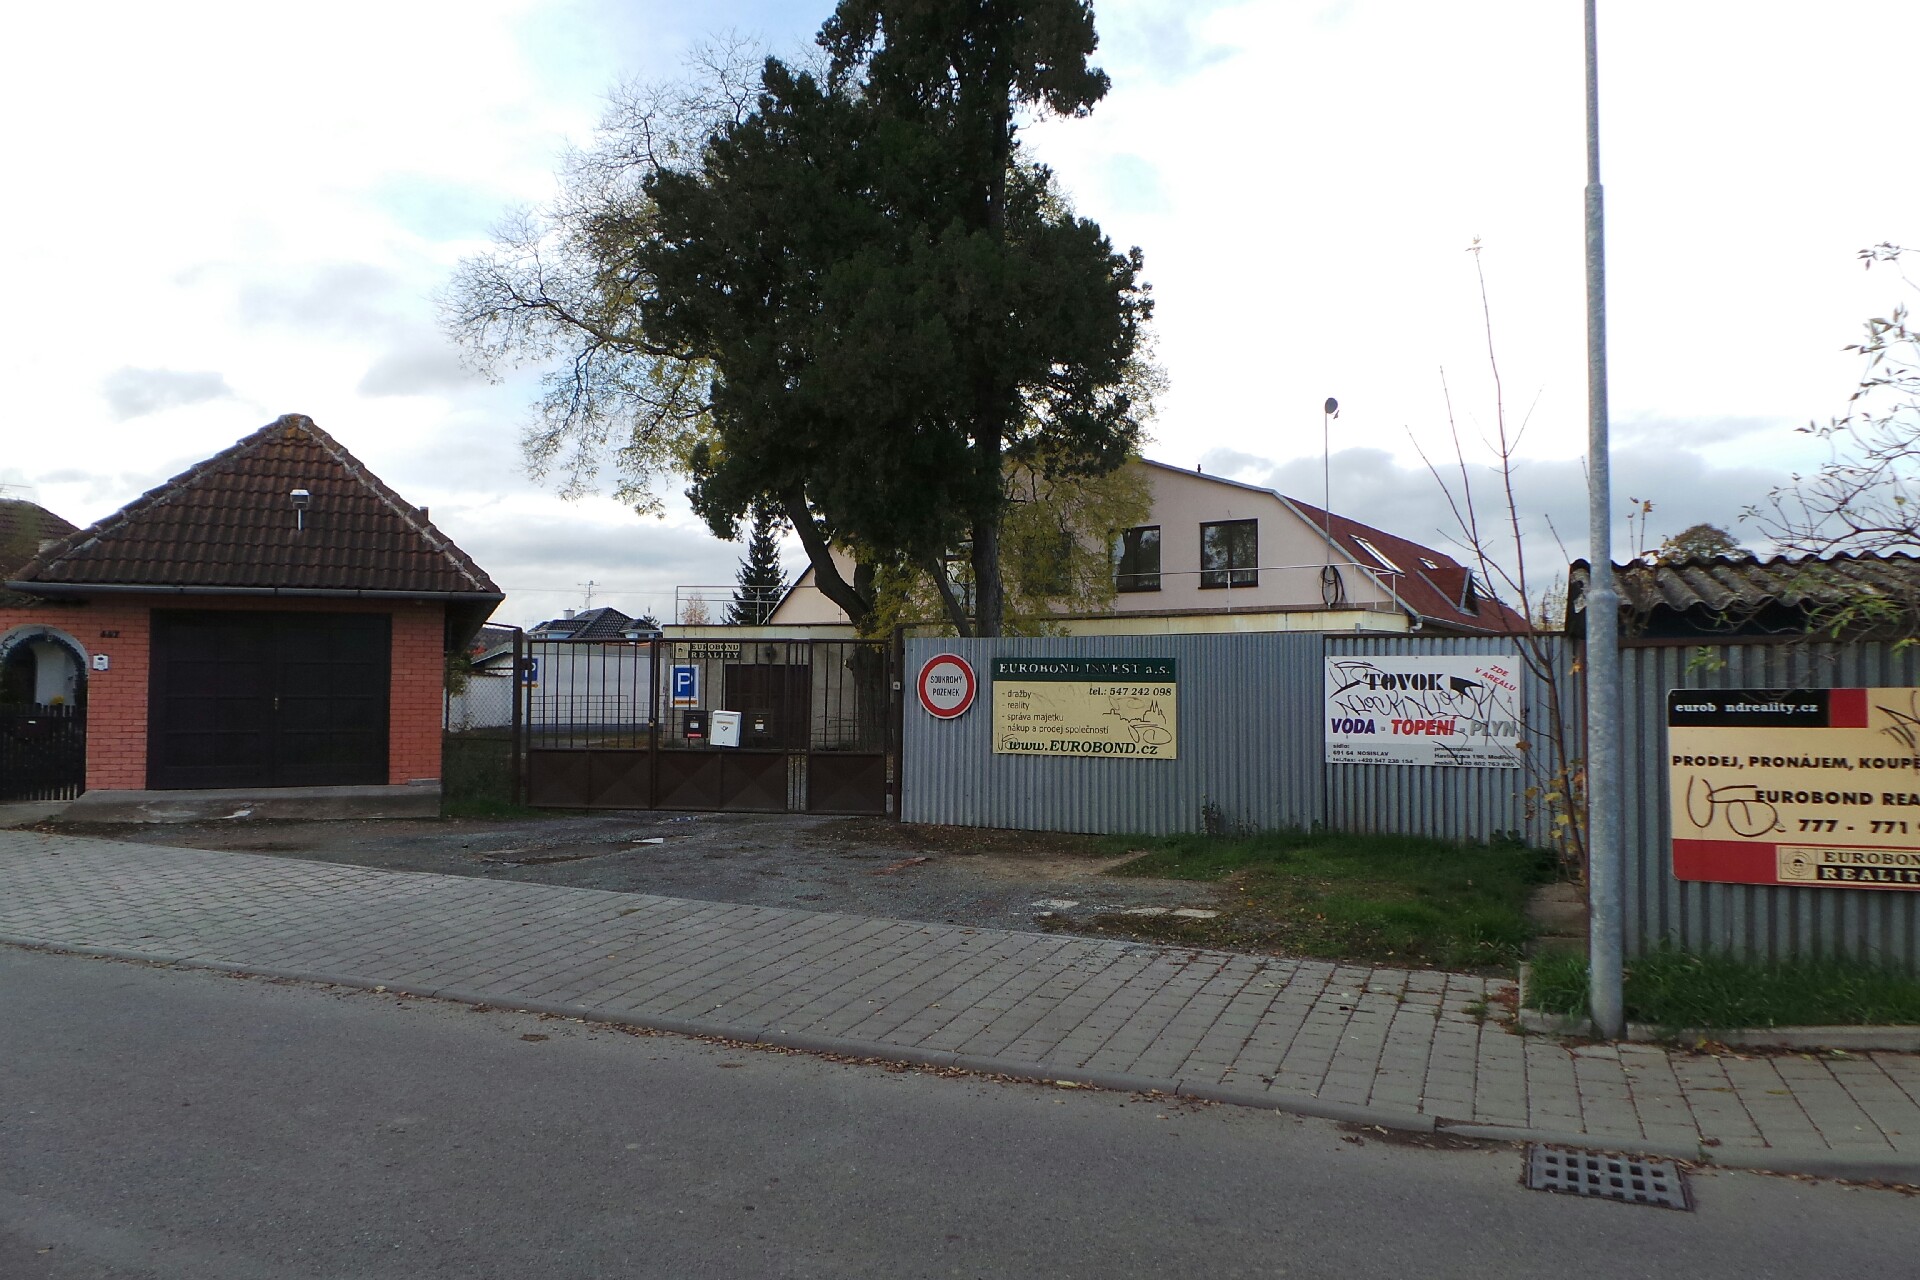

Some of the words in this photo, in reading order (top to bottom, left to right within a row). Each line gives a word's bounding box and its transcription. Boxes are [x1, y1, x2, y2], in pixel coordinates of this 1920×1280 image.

[691, 643, 739, 651] EUROBOND
[999, 663, 1080, 674] EUROBOND
[1086, 663, 1140, 674] INVEST
[1145, 665, 1171, 675] a.s.
[1490, 664, 1509, 677] ZDE
[677, 672, 693, 693] P
[1368, 673, 1444, 691] TOVOK
[932, 688, 960, 697] POZEMEK
[1007, 689, 1032, 699] dražby
[1089, 687, 1107, 696] tel.:
[1109, 687, 1128, 696] 547
[1131, 688, 1150, 696] 242
[1153, 688, 1172, 697] 098
[1007, 701, 1030, 711] reality
[1007, 712, 1031, 722] správa
[1033, 713, 1064, 723] majetku
[1007, 723, 1030, 733] nákup
[1039, 725, 1063, 734] prodej
[1331, 718, 1376, 734] VODA
[1391, 715, 1457, 736] TOPENÍ
[1469, 720, 1516, 737] PLYN
[1009, 740, 1158, 755] www.EUROBOND.cz
[1672, 755, 1744, 769] PRODEJ,
[1748, 753, 1854, 771] PRONÁJEM,
[1755, 790, 1873, 806] EUROBOND
[1798, 819, 1839, 833] 777
[1870, 820, 1908, 834] 771
[1822, 867, 1920, 883] REALIT
